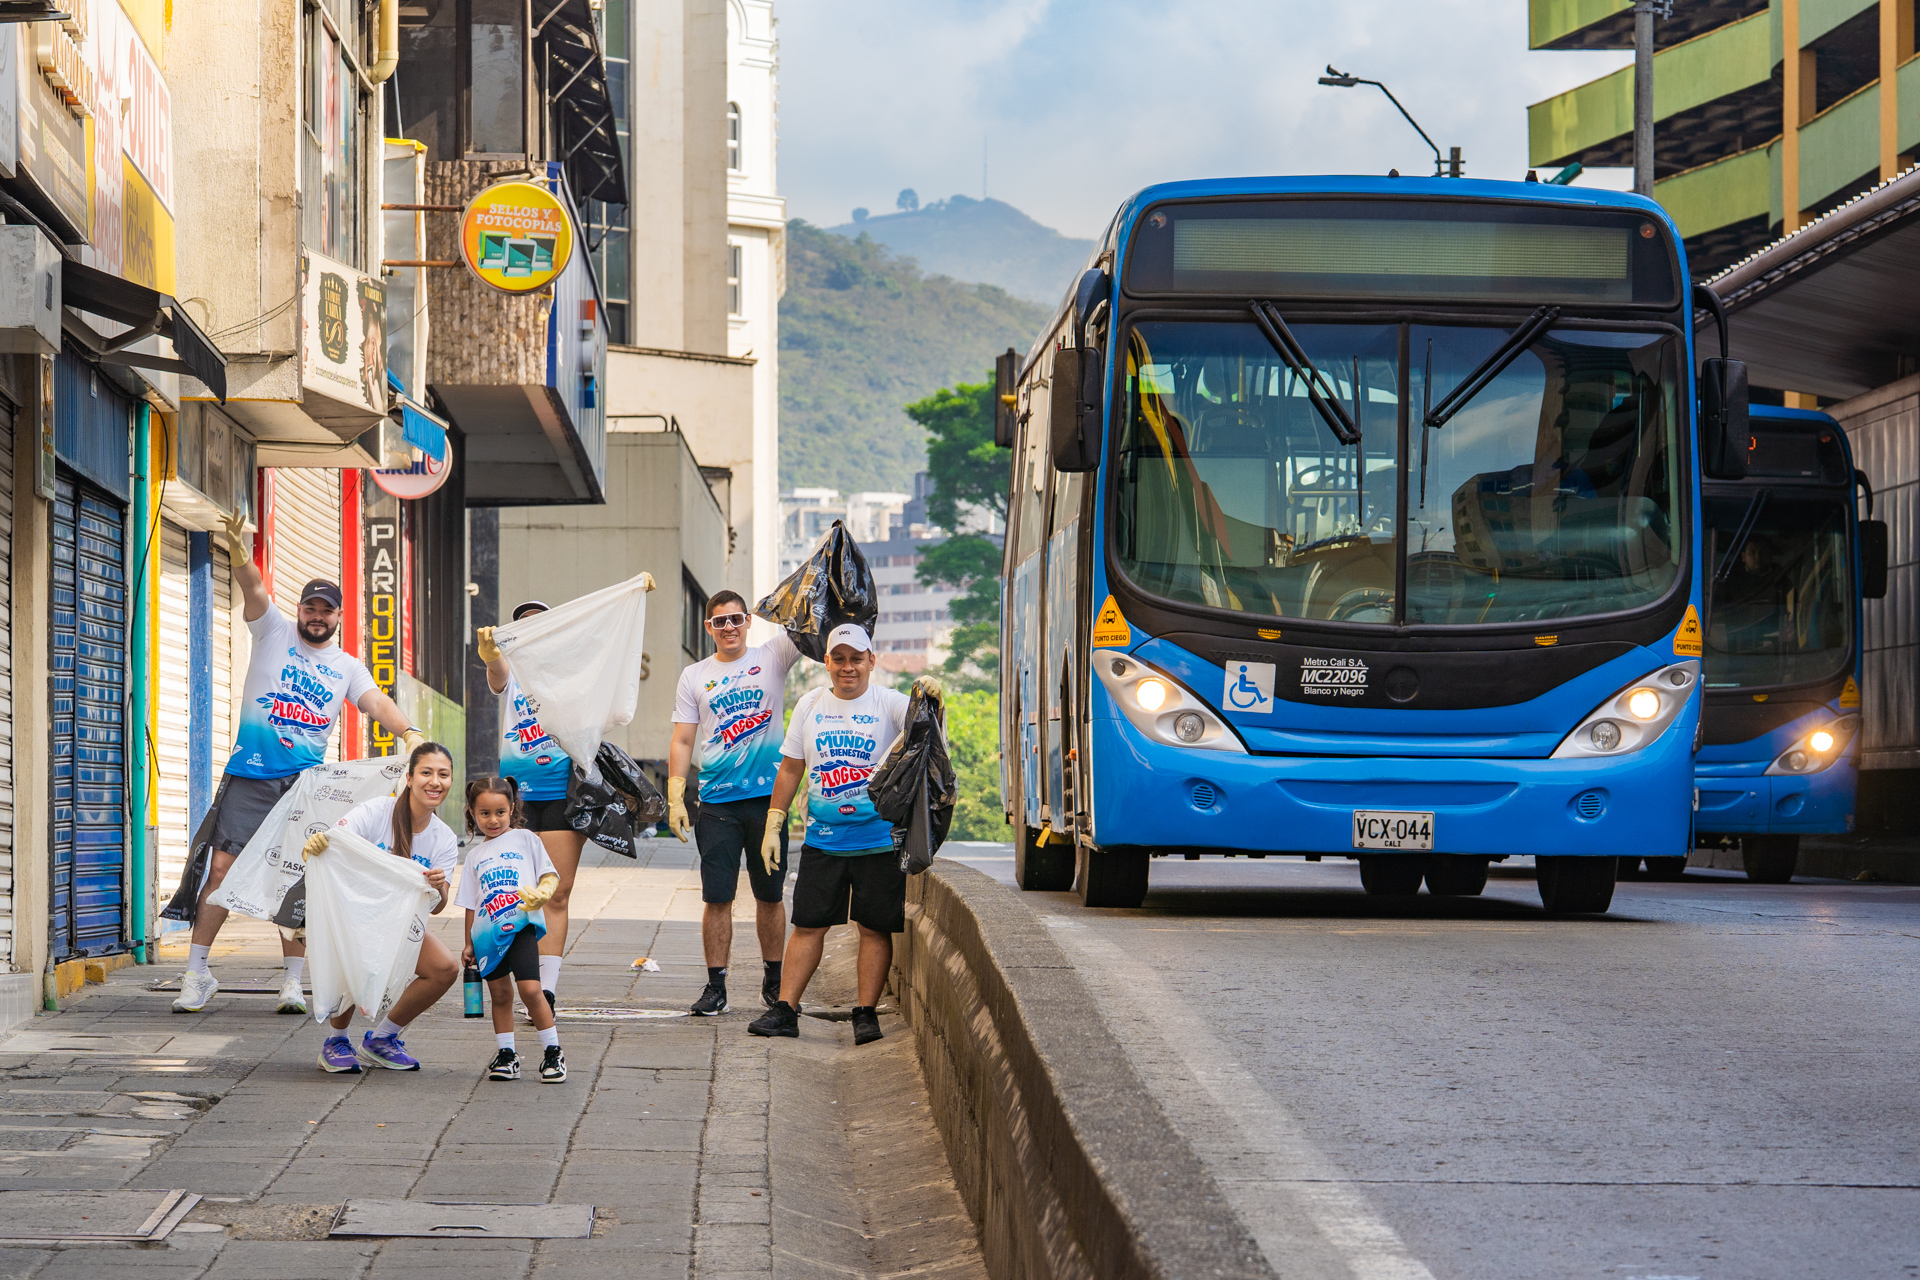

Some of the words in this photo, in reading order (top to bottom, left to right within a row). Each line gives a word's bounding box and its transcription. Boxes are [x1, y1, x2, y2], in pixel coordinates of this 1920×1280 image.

[129, 37, 169, 204] OUTLET
[490, 203, 539, 218] SELLOS
[542, 208, 552, 219] Y
[476, 214, 562, 232] FOTOCOPIAS
[371, 524, 394, 686] PARQUEO
[1304, 658, 1328, 666] Metro
[1329, 658, 1346, 666] Cali
[1348, 659, 1366, 667] S.A.
[1301, 669, 1367, 683] MC22096
[281, 668, 334, 703] MUNDO
[282, 682, 290, 690] DE
[1304, 687, 1331, 695] Blanco
[1340, 687, 1365, 697] Negro
[709, 689, 764, 715] MUNDO
[725, 701, 760, 715] BIENESTAR
[271, 698, 331, 726] PLOGGING
[815, 735, 876, 753] MUNDO
[830, 748, 871, 761] BIENESTAR
[820, 766, 876, 788] PLOGGIN
[329, 796, 354, 804] RECICLADO
[1384, 840, 1402, 848] CALI
[285, 870, 301, 878] MUNDO
[480, 869, 519, 890] MUNDO
[488, 879, 518, 890] BIENESTAR
[485, 892, 520, 916] PLOGGI
